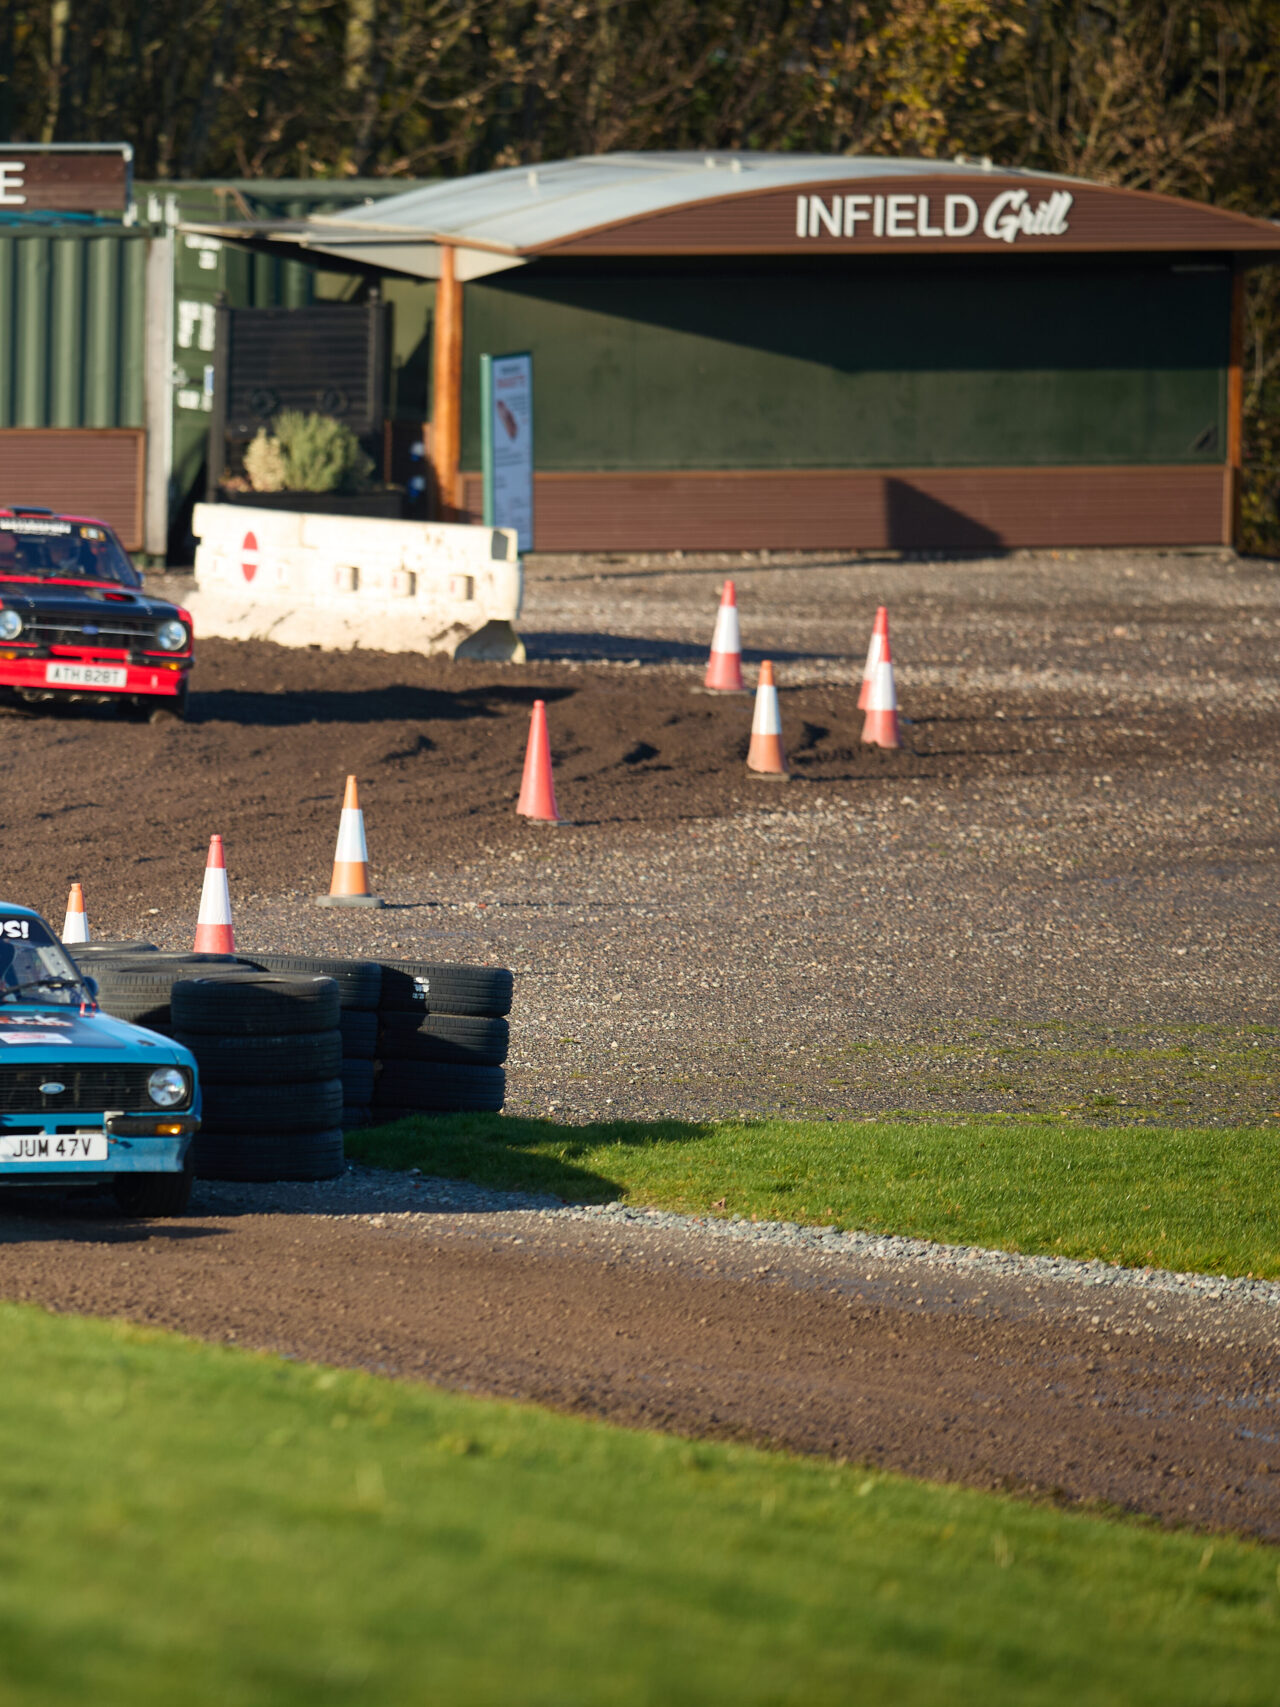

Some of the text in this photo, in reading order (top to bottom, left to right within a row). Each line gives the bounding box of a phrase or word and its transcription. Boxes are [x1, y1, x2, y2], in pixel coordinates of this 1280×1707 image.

[795, 188, 1074, 243] INFIELD Grill
[13, 1137, 92, 1158] JUM 47V
